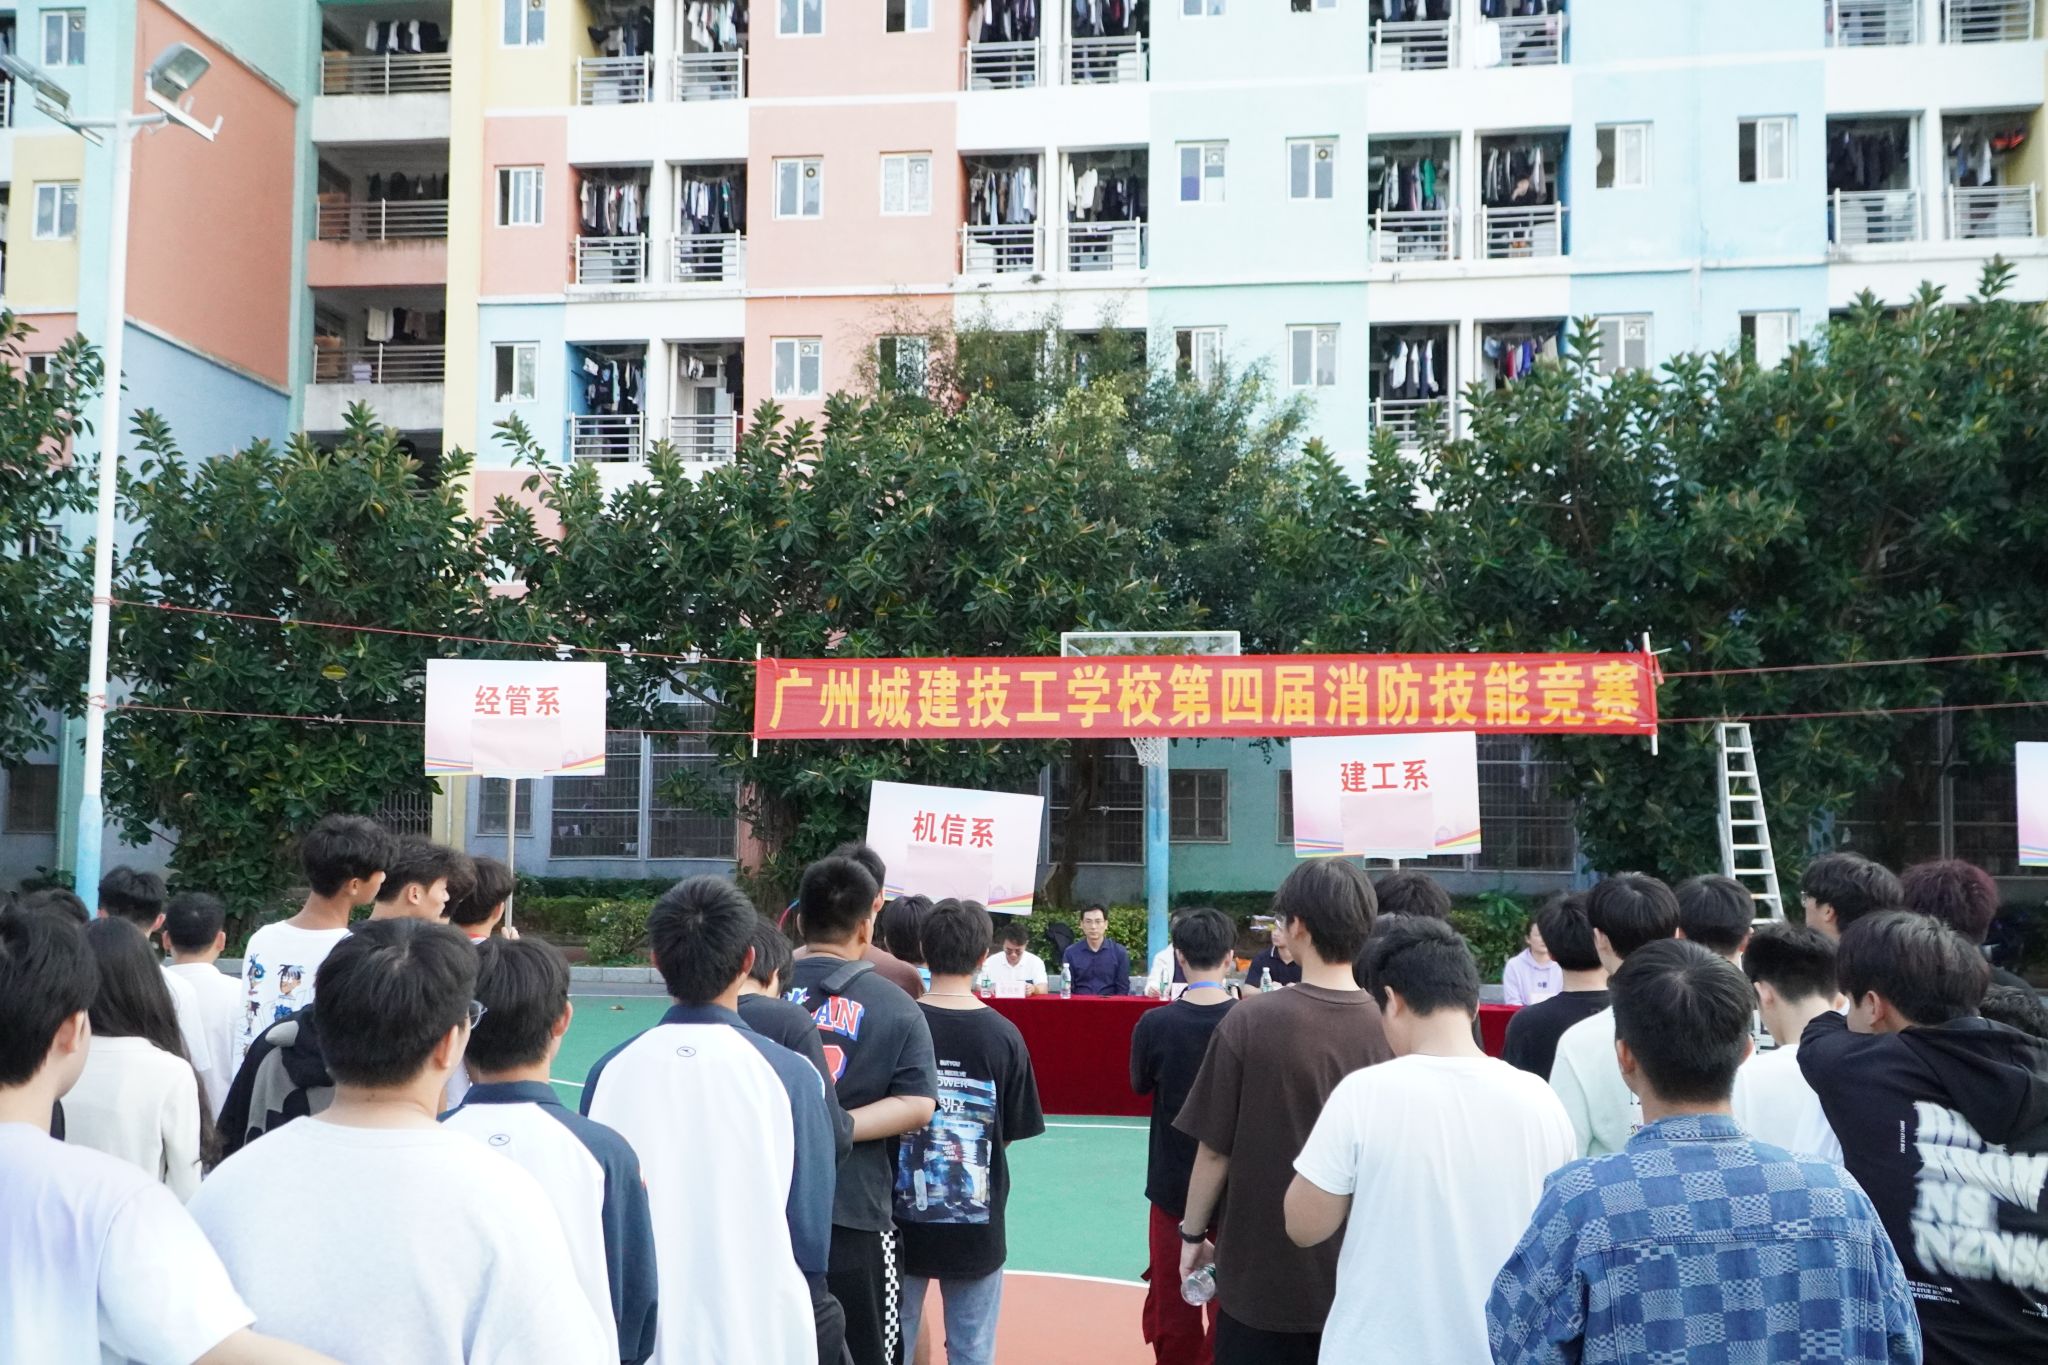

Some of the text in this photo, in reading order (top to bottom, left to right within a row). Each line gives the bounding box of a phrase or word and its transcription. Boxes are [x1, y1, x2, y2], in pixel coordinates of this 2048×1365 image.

[475, 685, 560, 716] 经管系
[770, 661, 1641, 729] 广州城建技工学校第四届消防技能竞赛
[1340, 759, 1430, 793] 建工系
[911, 810, 994, 849] 机信系
